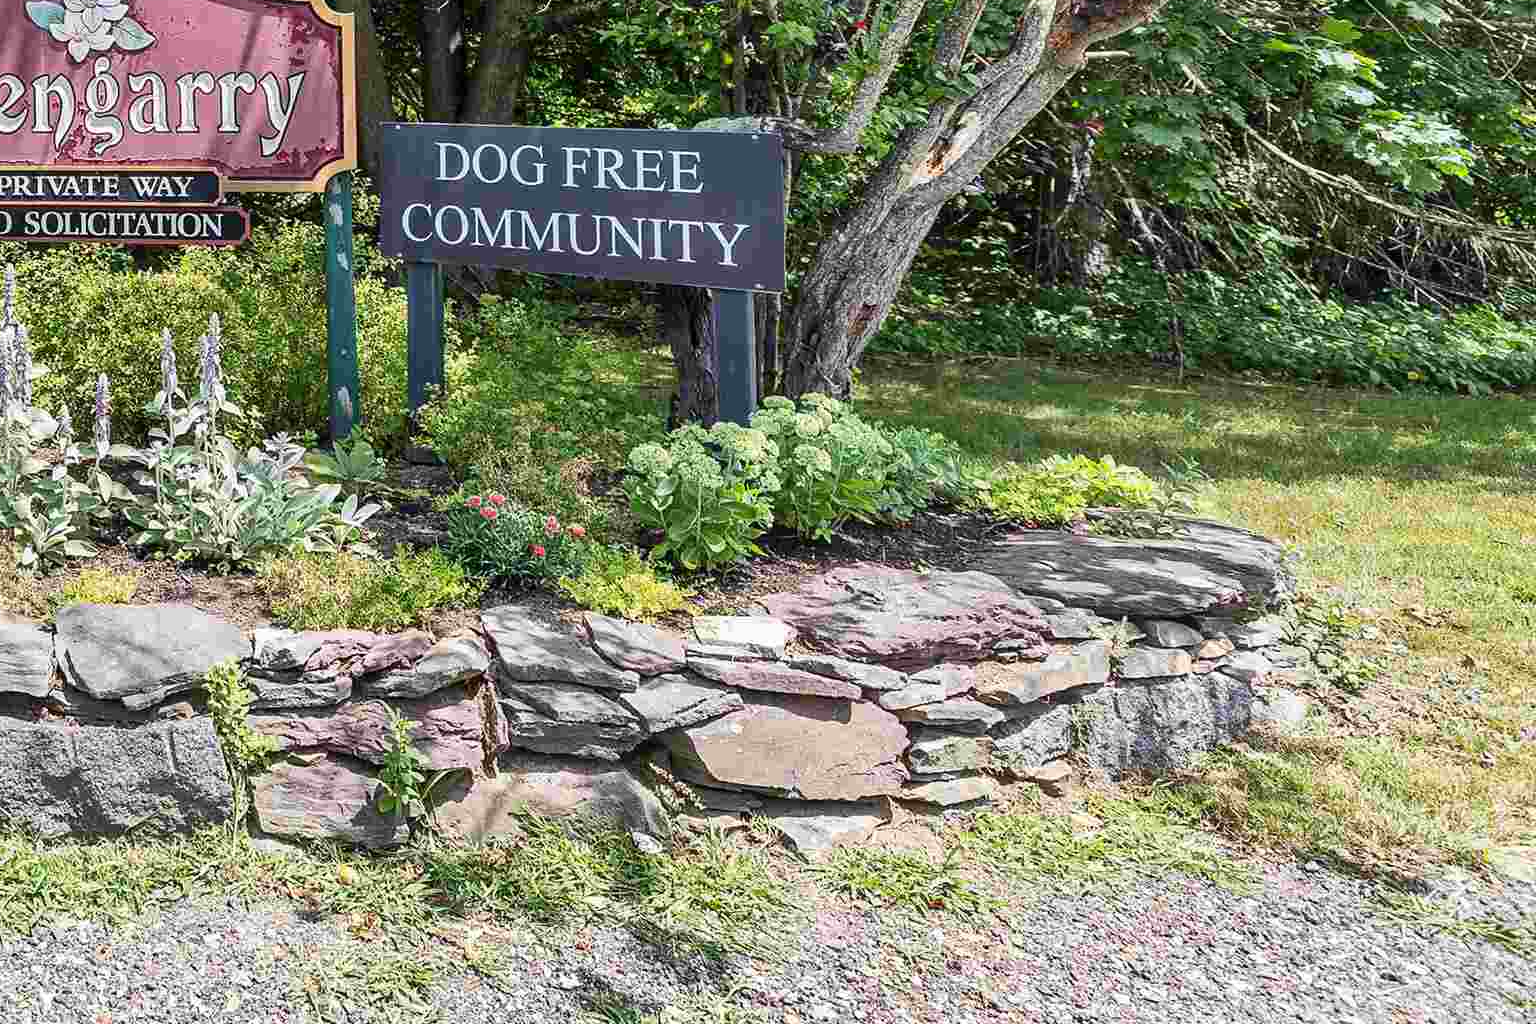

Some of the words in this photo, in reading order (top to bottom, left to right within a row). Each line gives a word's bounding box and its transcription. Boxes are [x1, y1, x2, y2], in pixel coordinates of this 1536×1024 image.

[128, 176, 194, 197] WAY
[434, 142, 547, 186] DOG
[562, 146, 704, 194] FREE
[24, 211, 223, 238] SOLICITATION
[401, 203, 751, 267] COMMUNITY
